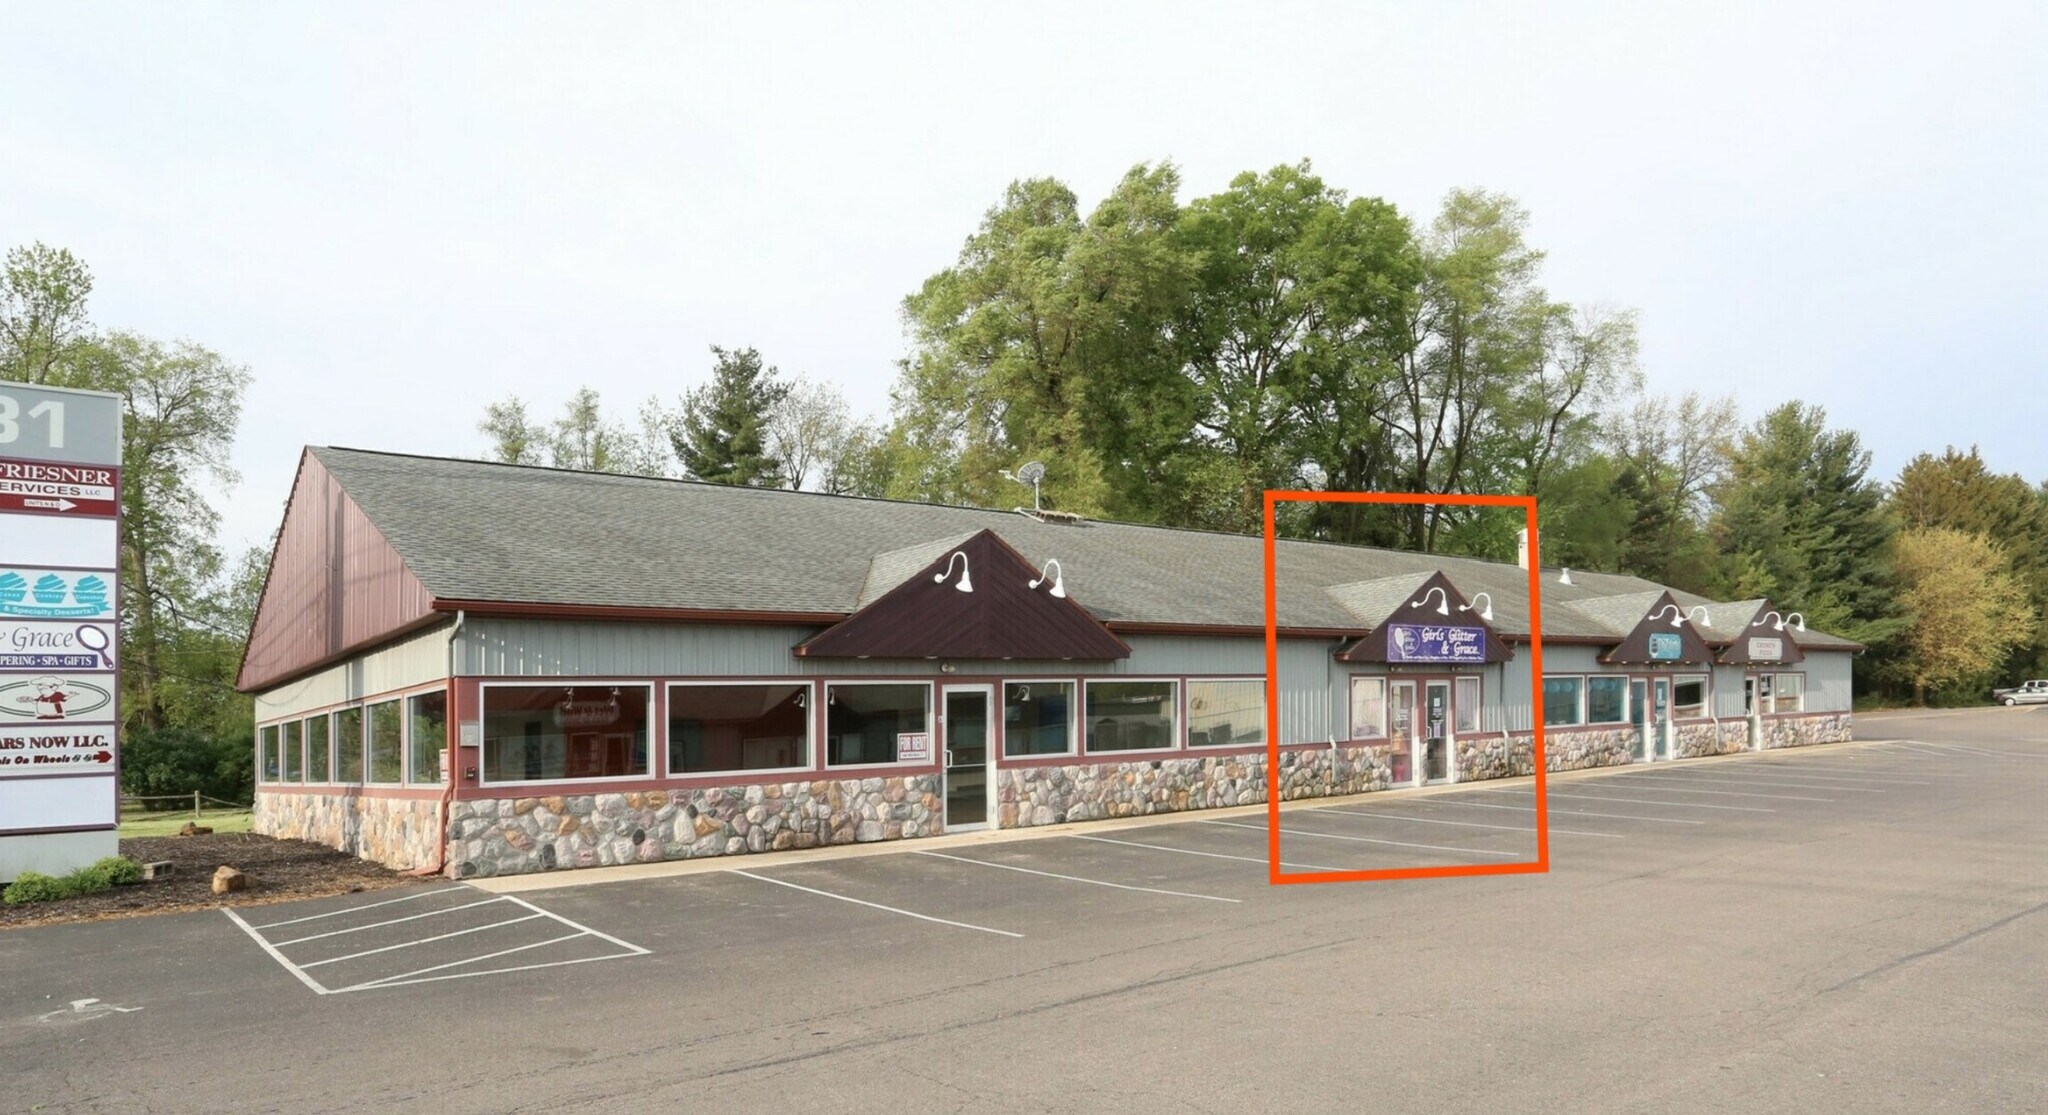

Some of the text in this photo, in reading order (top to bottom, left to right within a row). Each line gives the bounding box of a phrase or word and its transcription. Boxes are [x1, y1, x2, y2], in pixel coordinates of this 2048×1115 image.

[13, 606, 52, 616] Specialty
[54, 607, 95, 616] Desserts!
[12, 626, 73, 652] Grace
[1422, 627, 1445, 643] Girls
[1448, 628, 1477, 644] Glitter
[1441, 640, 1449, 654] &
[41, 655, 61, 666] SPA
[64, 656, 92, 667] GIFTS
[29, 736, 70, 749] NOW
[73, 735, 109, 748] LLC.
[899, 735, 926, 751] FOR RENT
[14, 755, 30, 765] On
[33, 754, 71, 764] Wheels
